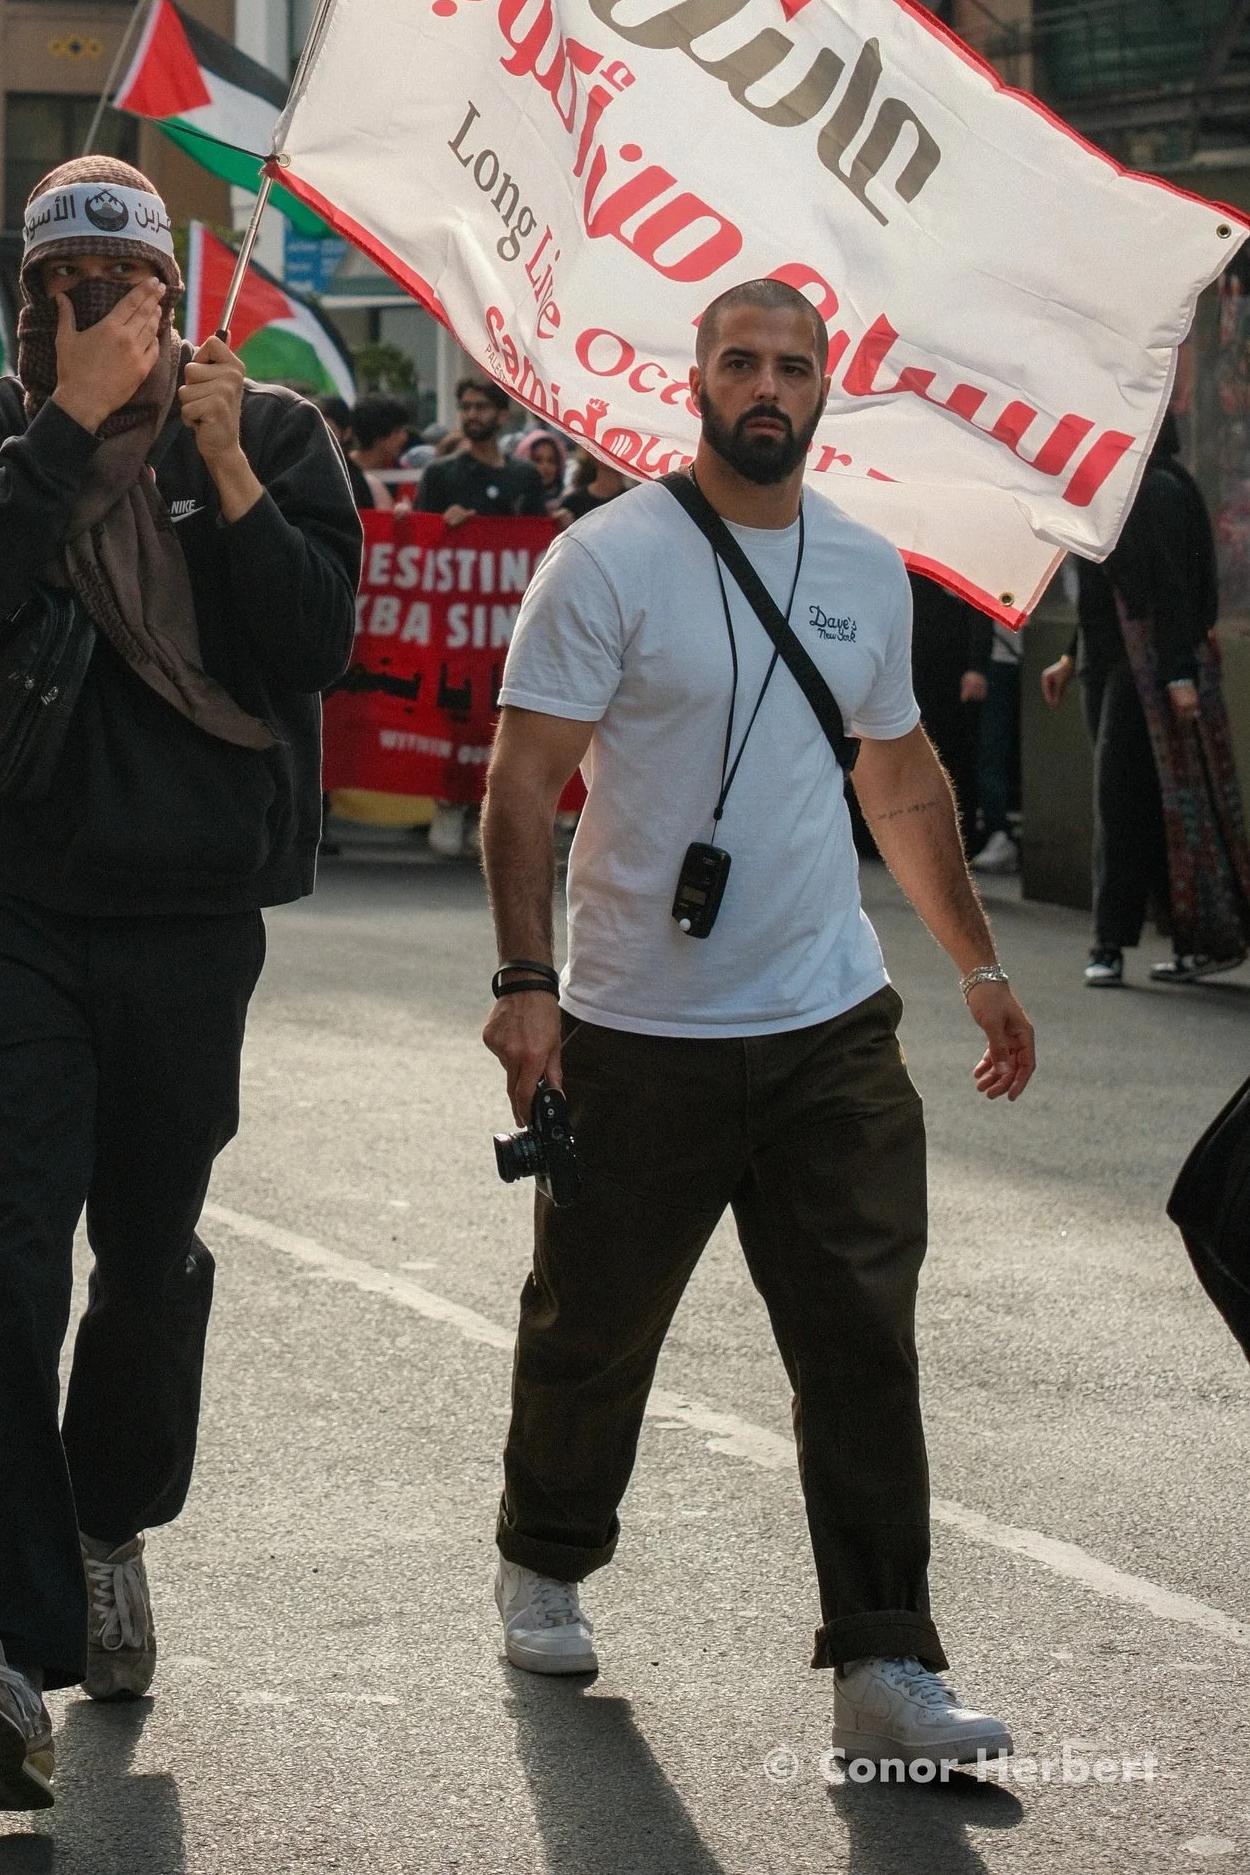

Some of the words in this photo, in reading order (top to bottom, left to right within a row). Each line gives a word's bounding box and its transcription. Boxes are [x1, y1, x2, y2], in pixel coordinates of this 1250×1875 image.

[447, 99, 538, 262] Long
[524, 223, 562, 341] Live
[574, 327, 853, 473] Octr
[171, 499, 197, 515] NIKE
[366, 542, 550, 595] ESISTIN
[446, 603, 520, 650] SIN
